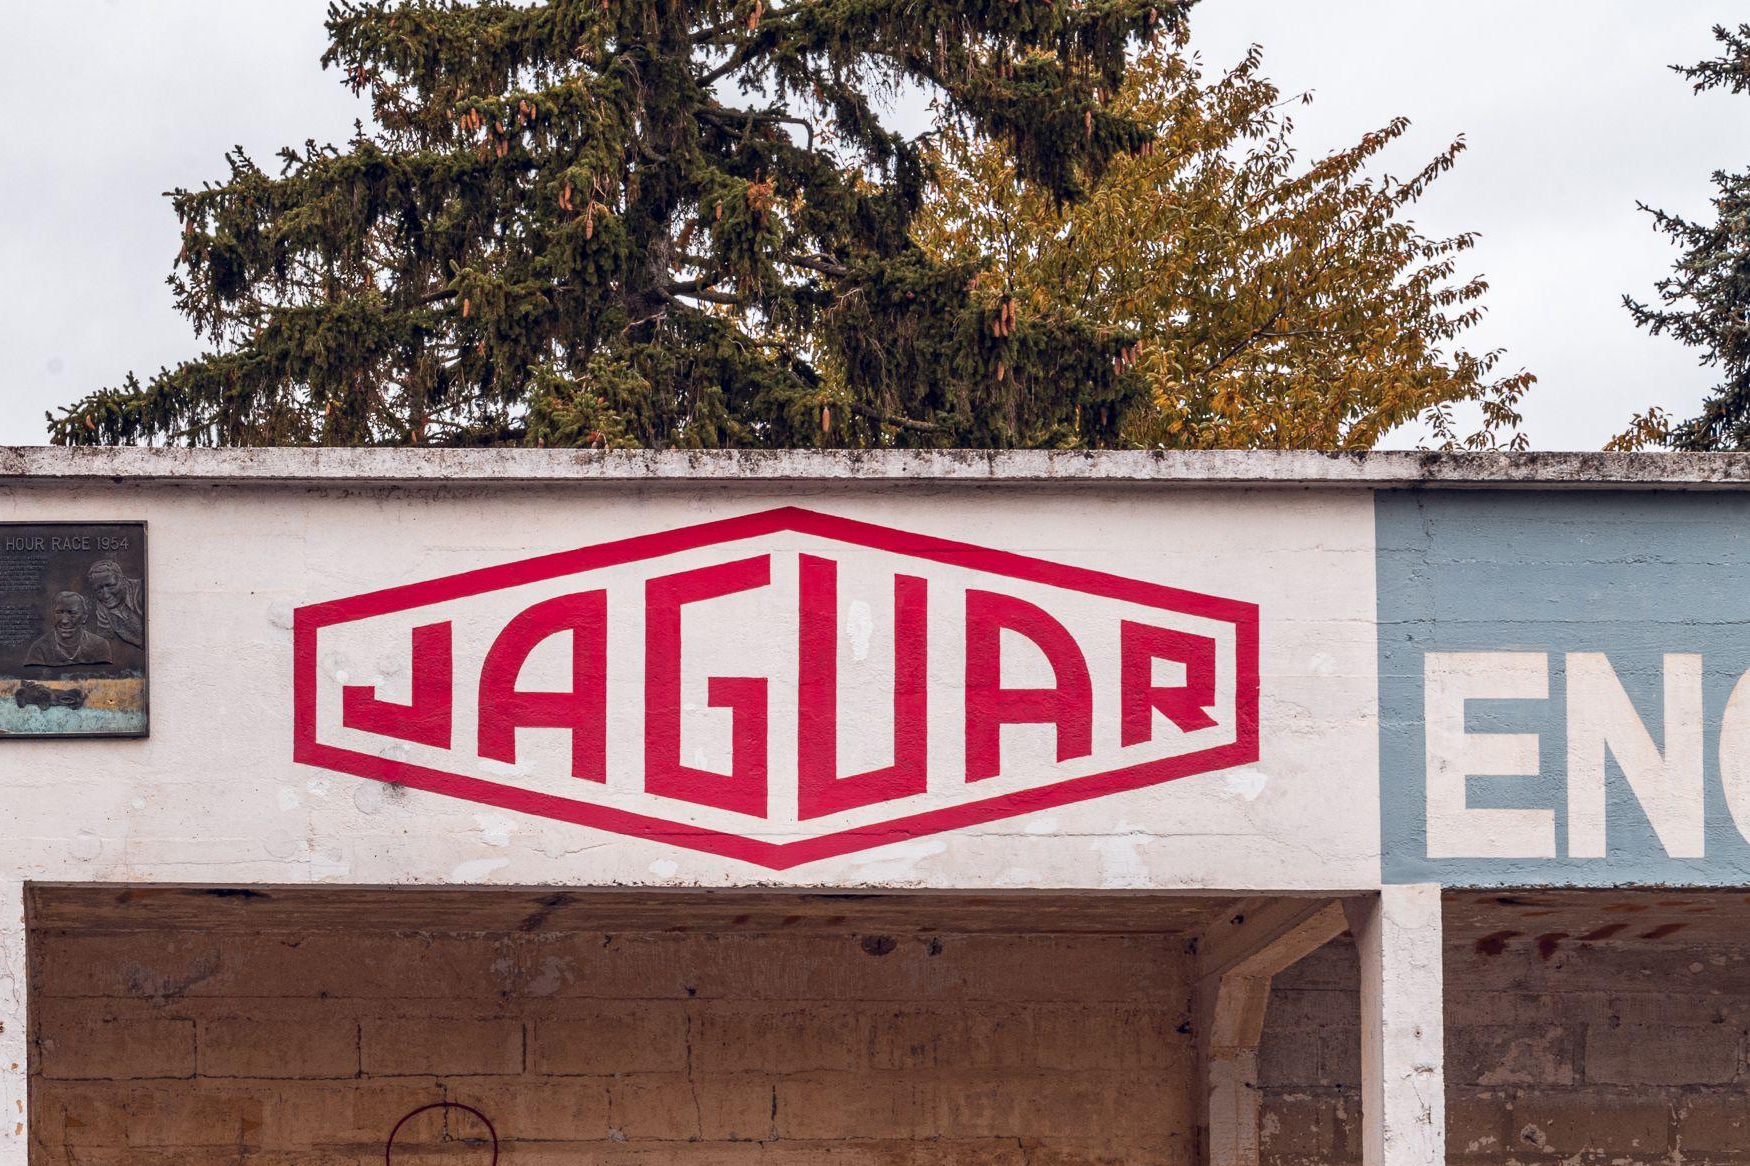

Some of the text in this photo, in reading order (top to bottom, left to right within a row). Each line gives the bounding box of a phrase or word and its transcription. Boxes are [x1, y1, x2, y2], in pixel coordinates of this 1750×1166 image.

[6, 536, 45, 551] HOUR
[51, 536, 90, 550] RACE
[96, 536, 130, 550] 1954
[343, 553, 1217, 820] JAGUAR
[1424, 652, 1750, 858] EN
